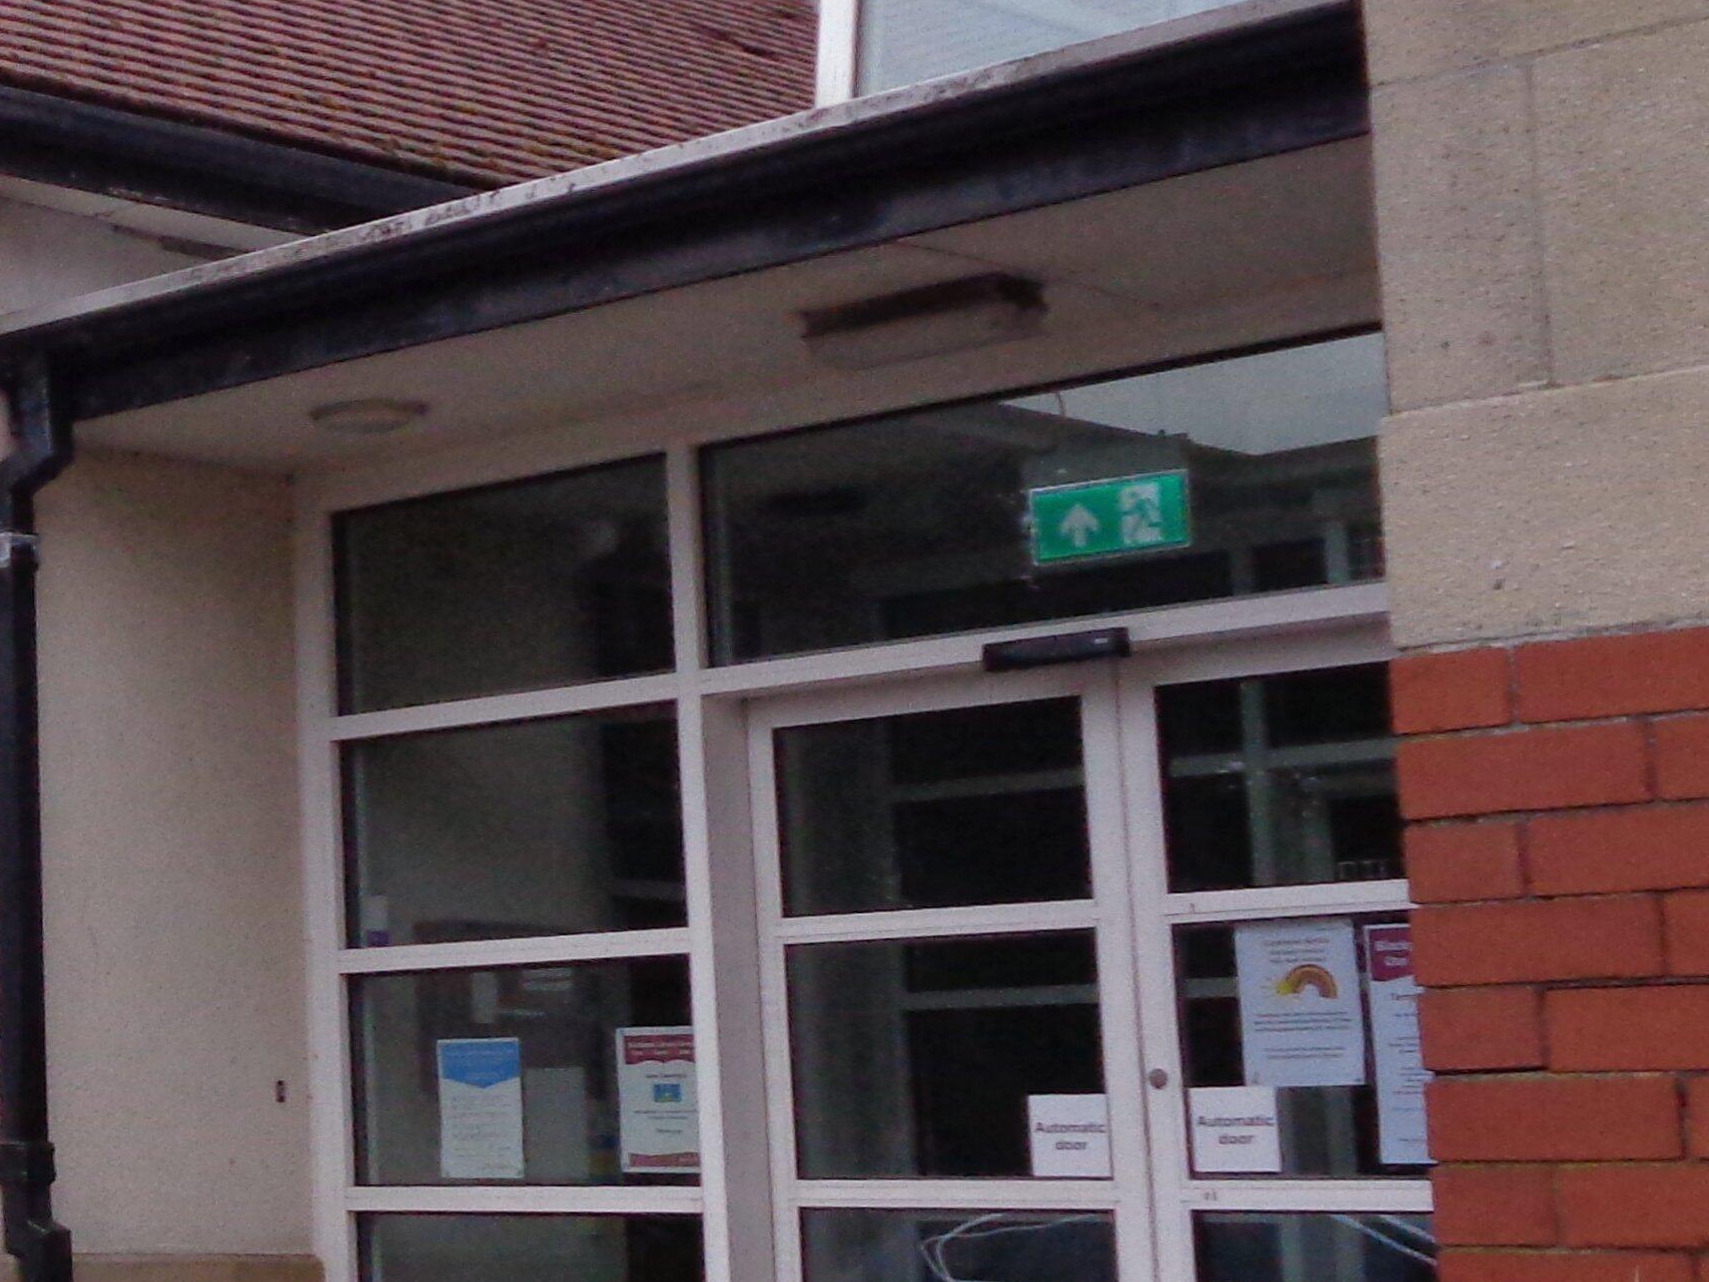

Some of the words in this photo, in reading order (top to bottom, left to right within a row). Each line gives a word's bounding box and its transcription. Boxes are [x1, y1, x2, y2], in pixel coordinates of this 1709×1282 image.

[1197, 1114, 1275, 1128] Automatic
[1034, 1122, 1107, 1134] Automatic
[1218, 1132, 1256, 1145] door
[1055, 1140, 1088, 1151] door
